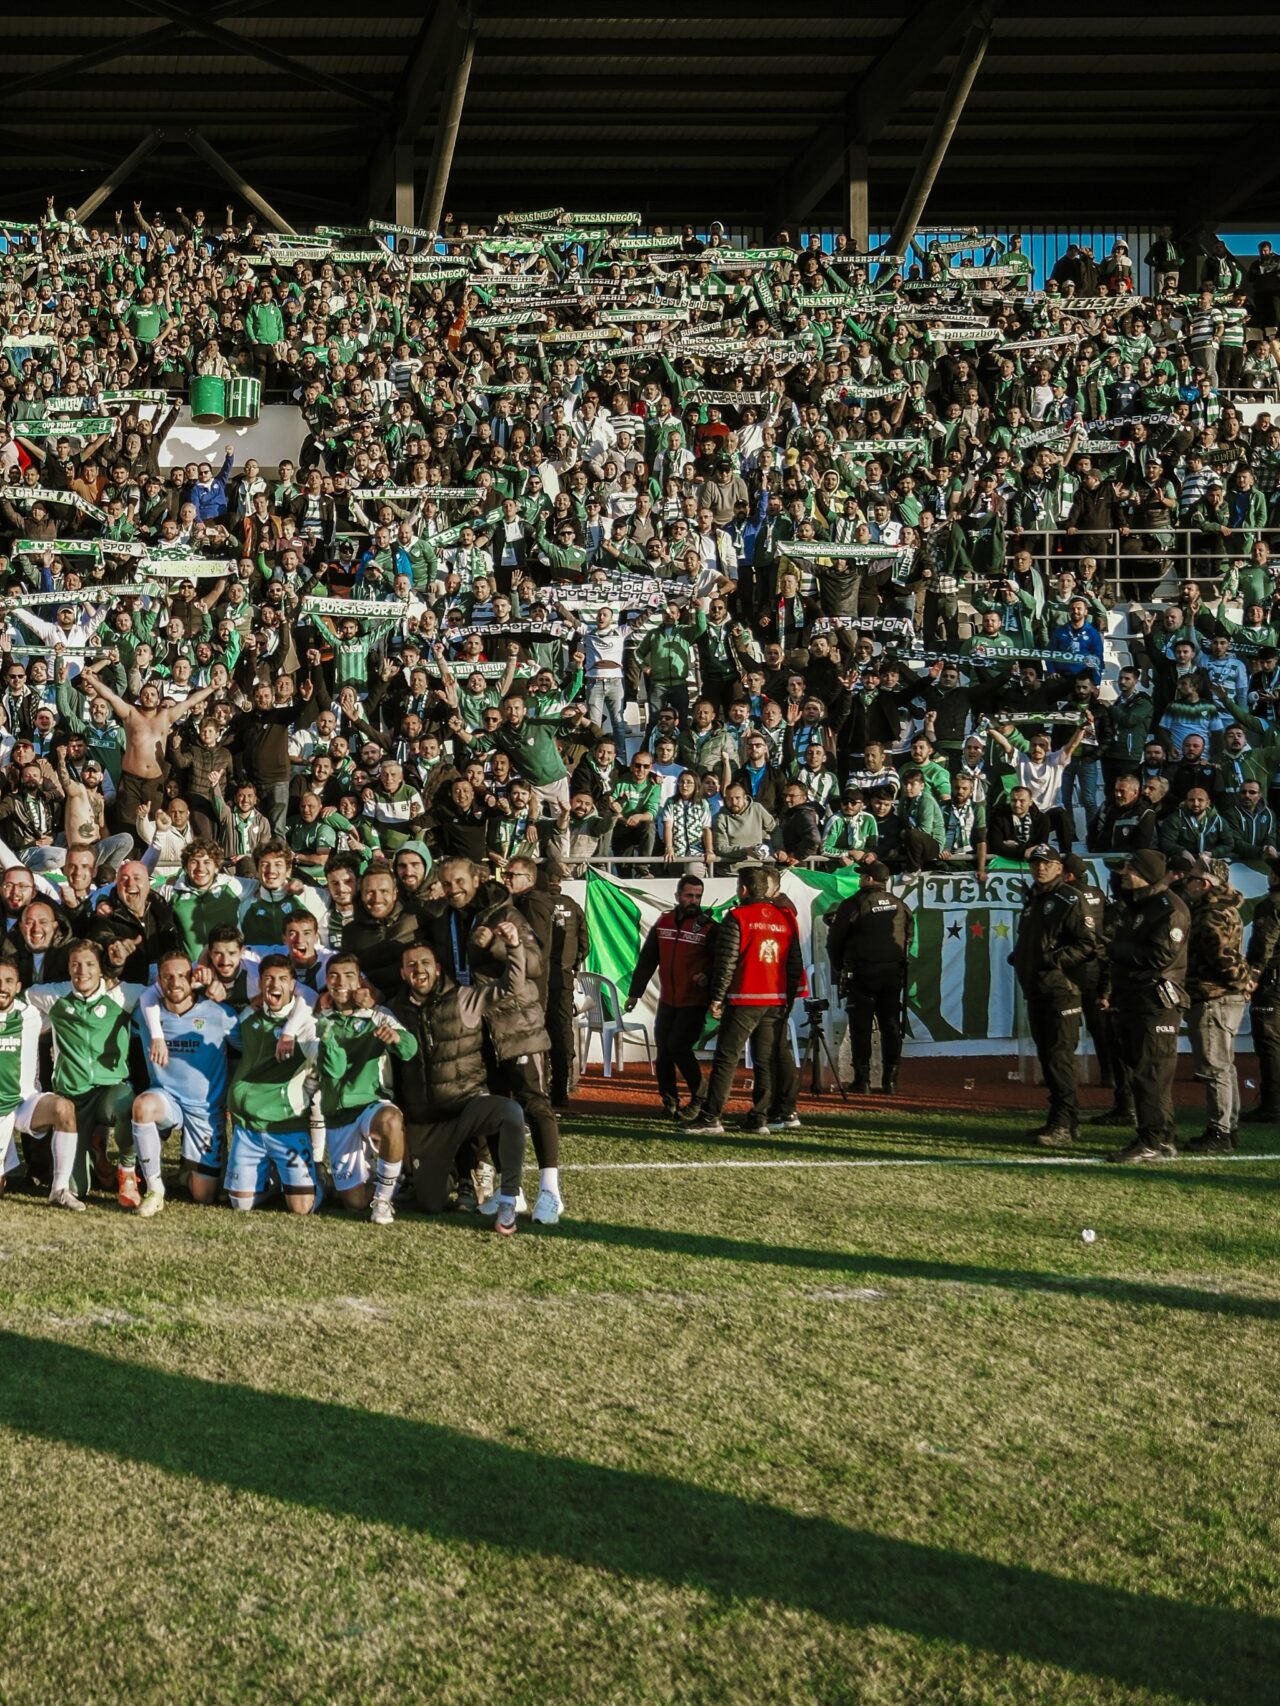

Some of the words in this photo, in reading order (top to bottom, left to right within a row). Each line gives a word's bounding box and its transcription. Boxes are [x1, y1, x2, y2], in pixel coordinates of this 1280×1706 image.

[574, 212, 606, 223] TEKSAS
[543, 230, 601, 242] TEXAS
[619, 238, 652, 249] TEKSAS
[725, 250, 776, 260] TEXAS
[411, 270, 438, 282] EKSAS
[610, 313, 676, 322] BURSASPOR
[853, 440, 907, 451] TEXAS
[15, 487, 57, 499] GREEN
[31, 541, 92, 553] TEXAS
[21, 591, 99, 607] BURSASPOR
[319, 602, 388, 617] BURSASPOR
[816, 617, 905, 633] USASPOR
[986, 647, 1085, 662] BURSASPOR
[926, 876, 1026, 903] TEKS
[166, 1039, 200, 1048] OSBİR
